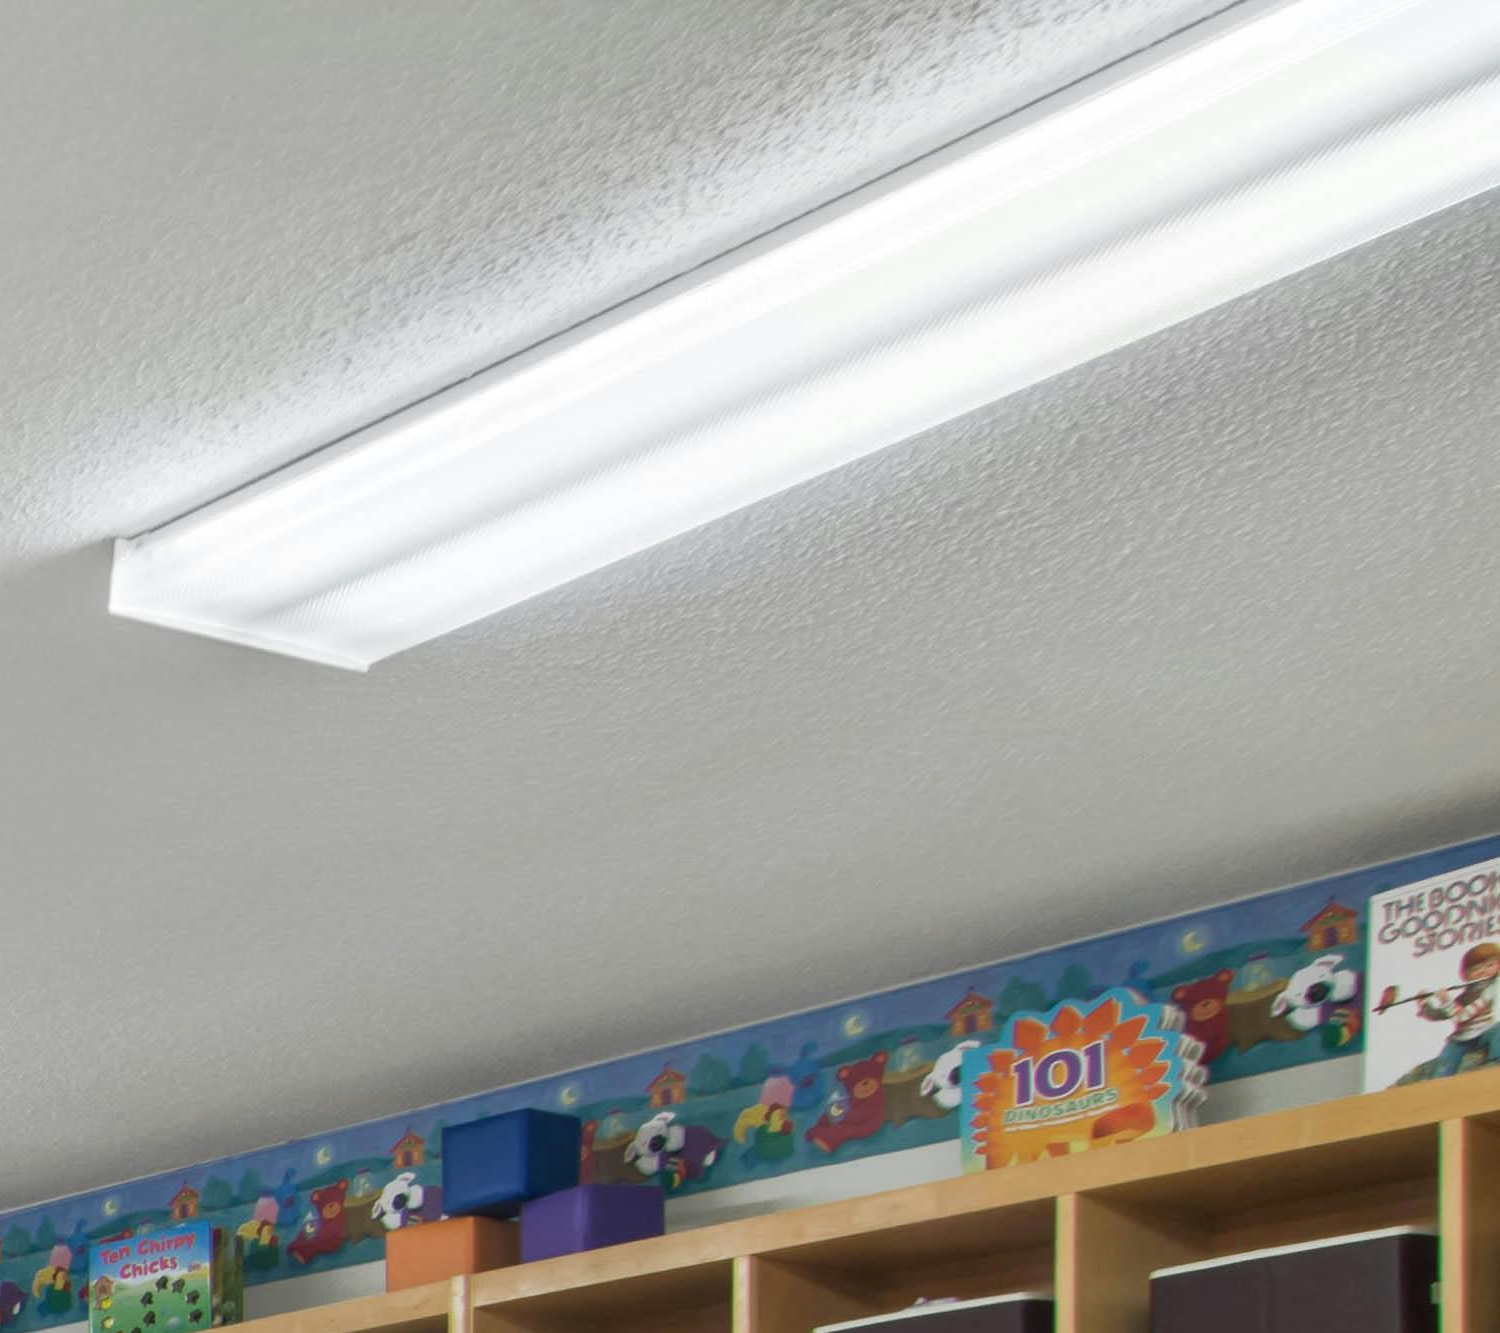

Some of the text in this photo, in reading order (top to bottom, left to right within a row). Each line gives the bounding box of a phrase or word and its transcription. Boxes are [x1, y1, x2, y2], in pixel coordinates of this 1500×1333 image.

[1382, 892, 1426, 922] THE
[1011, 1040, 1106, 1106] 101
[1004, 1088, 1118, 1125] DINOSAURS
[100, 1232, 197, 1266] Ten Chirpy
[120, 1256, 178, 1279] Chicks
